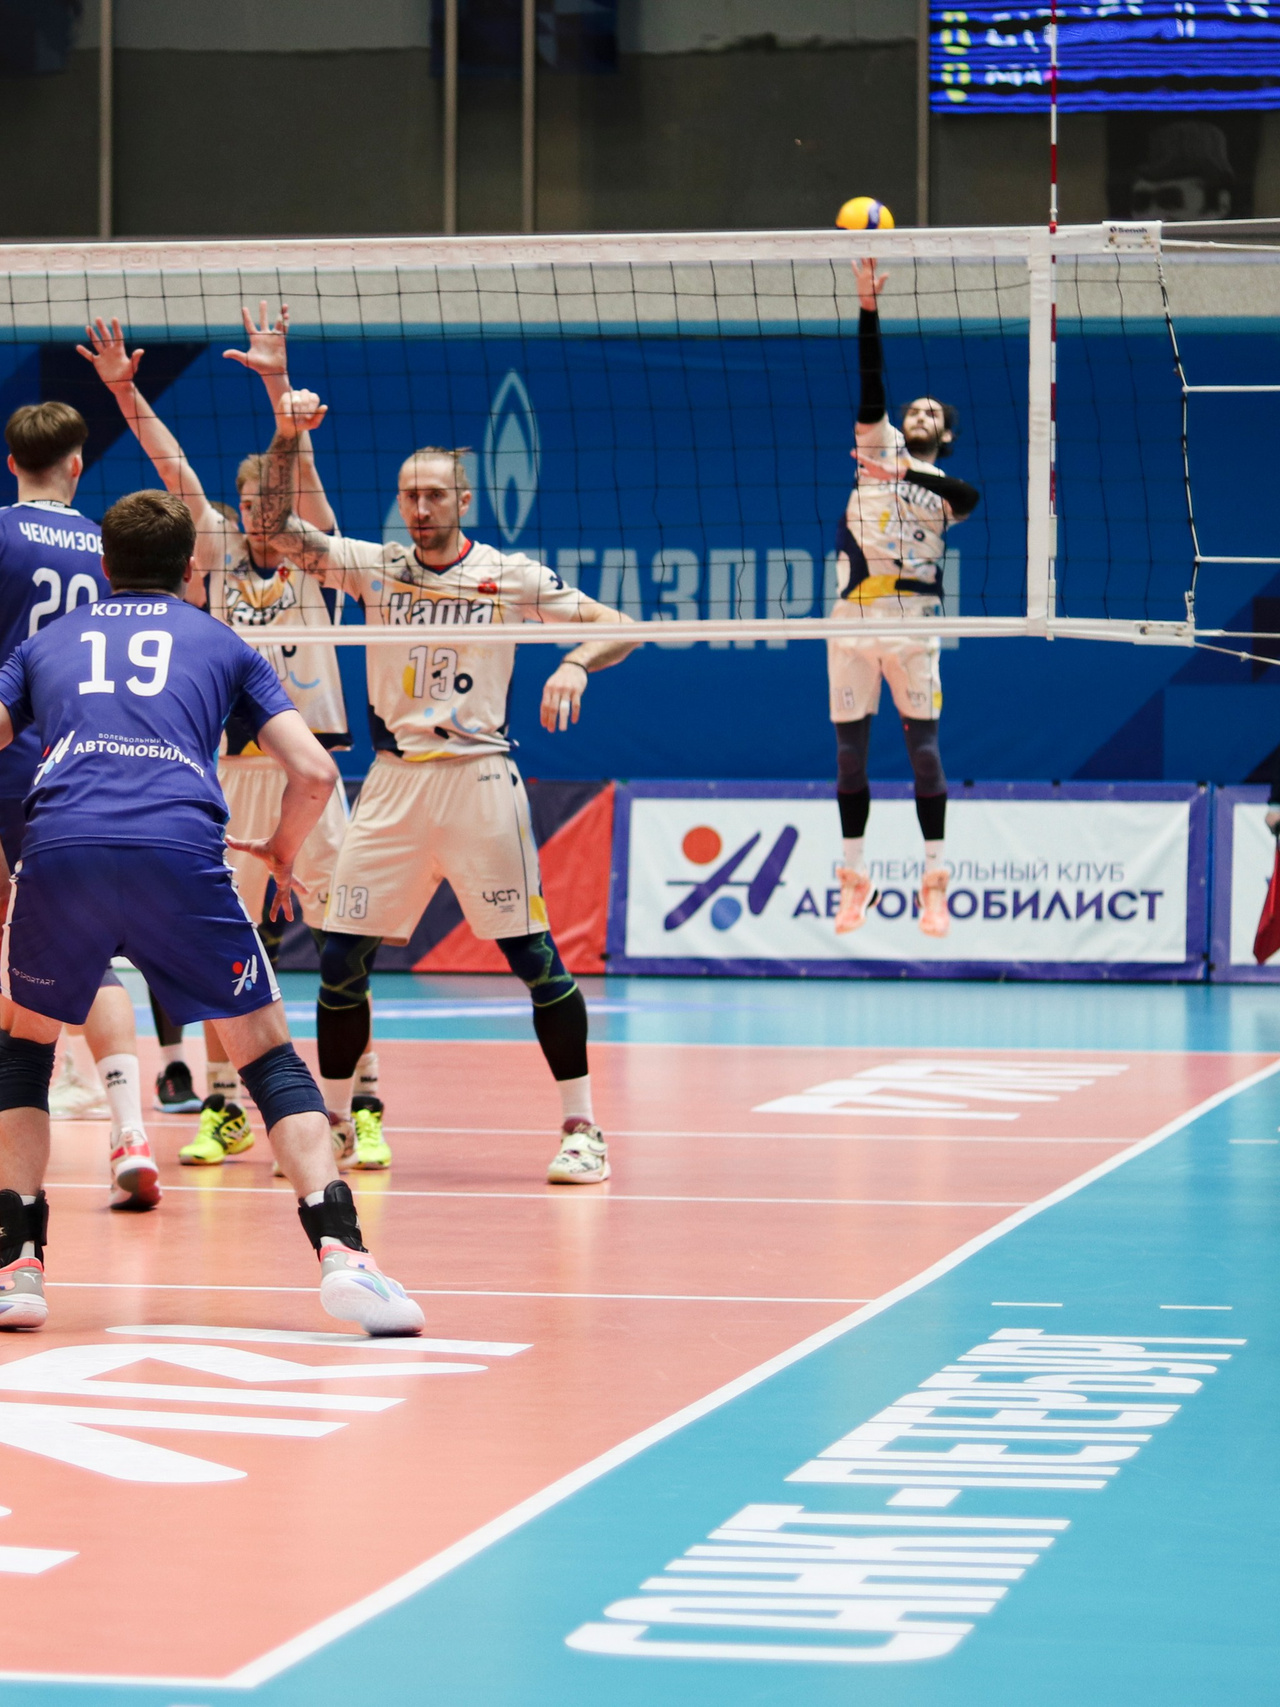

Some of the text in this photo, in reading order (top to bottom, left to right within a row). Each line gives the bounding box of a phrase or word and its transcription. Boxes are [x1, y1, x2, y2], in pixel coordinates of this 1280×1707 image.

[28, 567, 99, 637] 20
[90, 602, 168, 616] КОТОВ
[78, 630, 173, 696] 19
[409, 645, 458, 701] 13
[1058, 861, 1125, 883] КЛУБ
[336, 884, 369, 920] 13
[565, 1328, 1248, 1663] САНКТ-ПЕТЕРБУРГ
